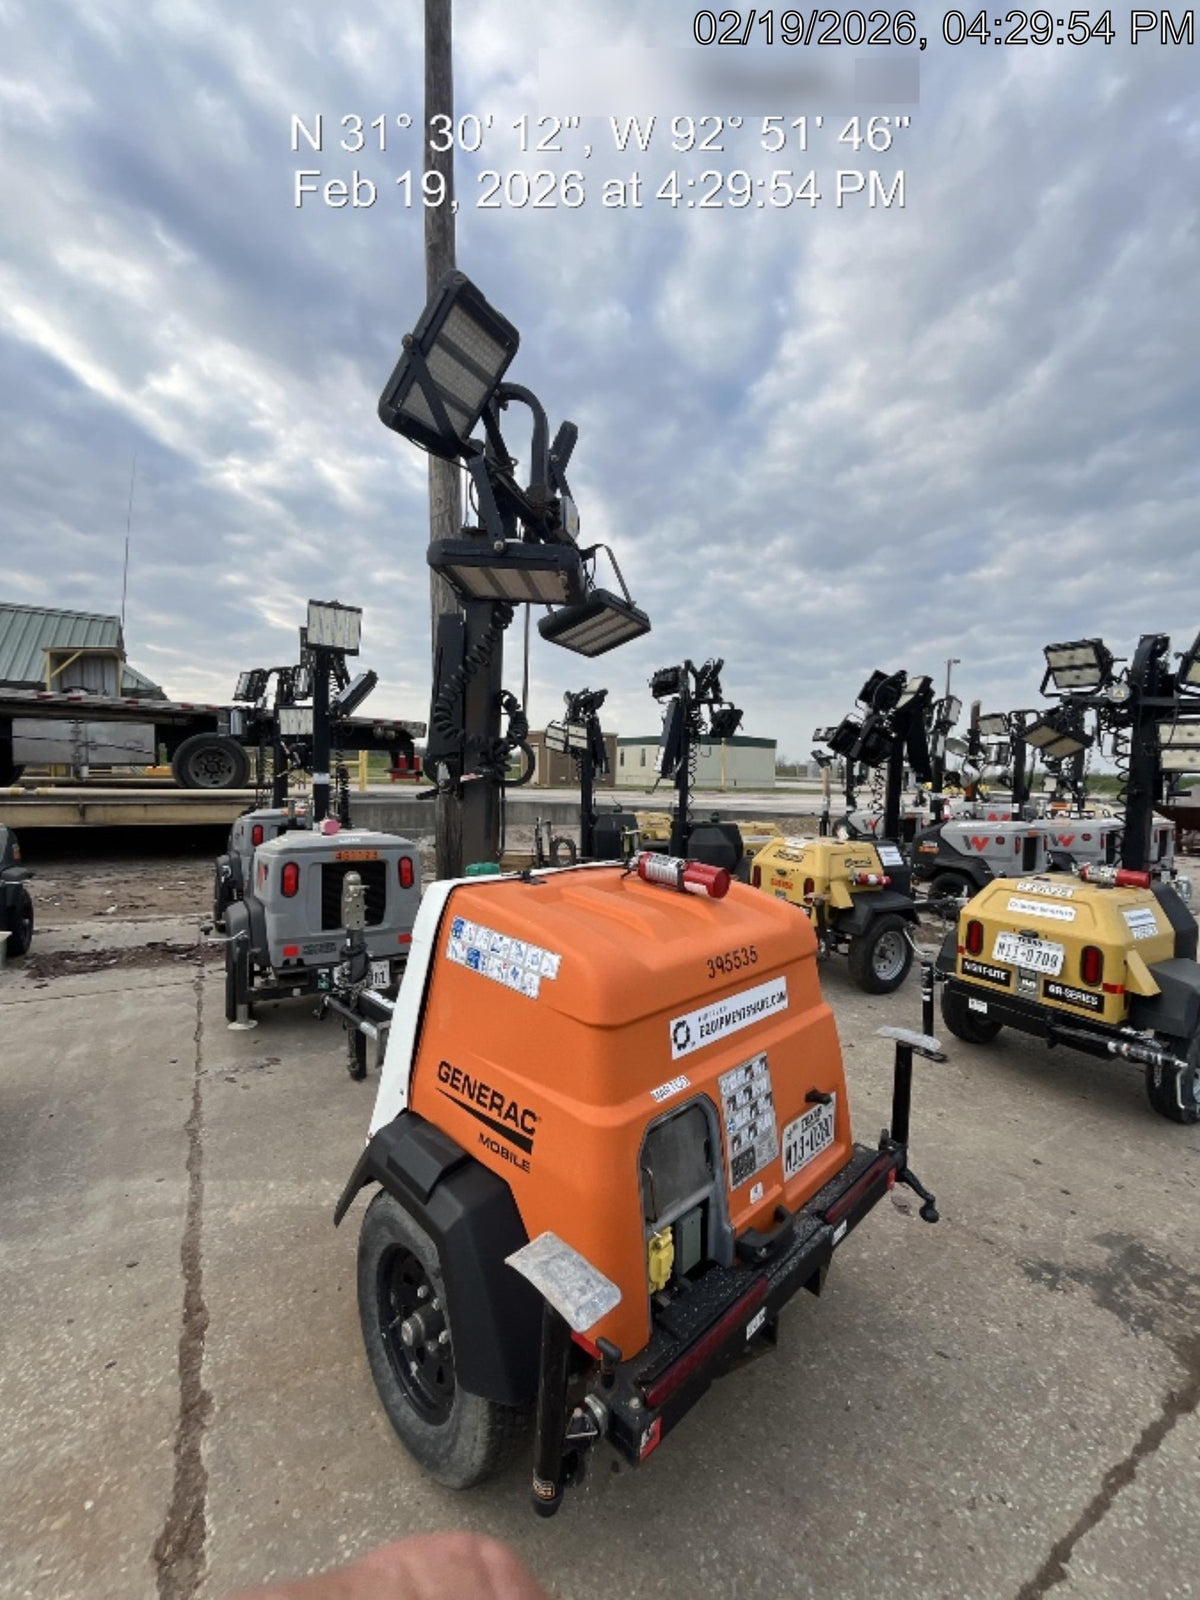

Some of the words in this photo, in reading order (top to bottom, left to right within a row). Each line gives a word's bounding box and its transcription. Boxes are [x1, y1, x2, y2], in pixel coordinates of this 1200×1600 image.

[707, 946, 759, 979] 395535
[437, 1060, 538, 1137] GENERAC
[478, 1132, 532, 1174] MOBILE
